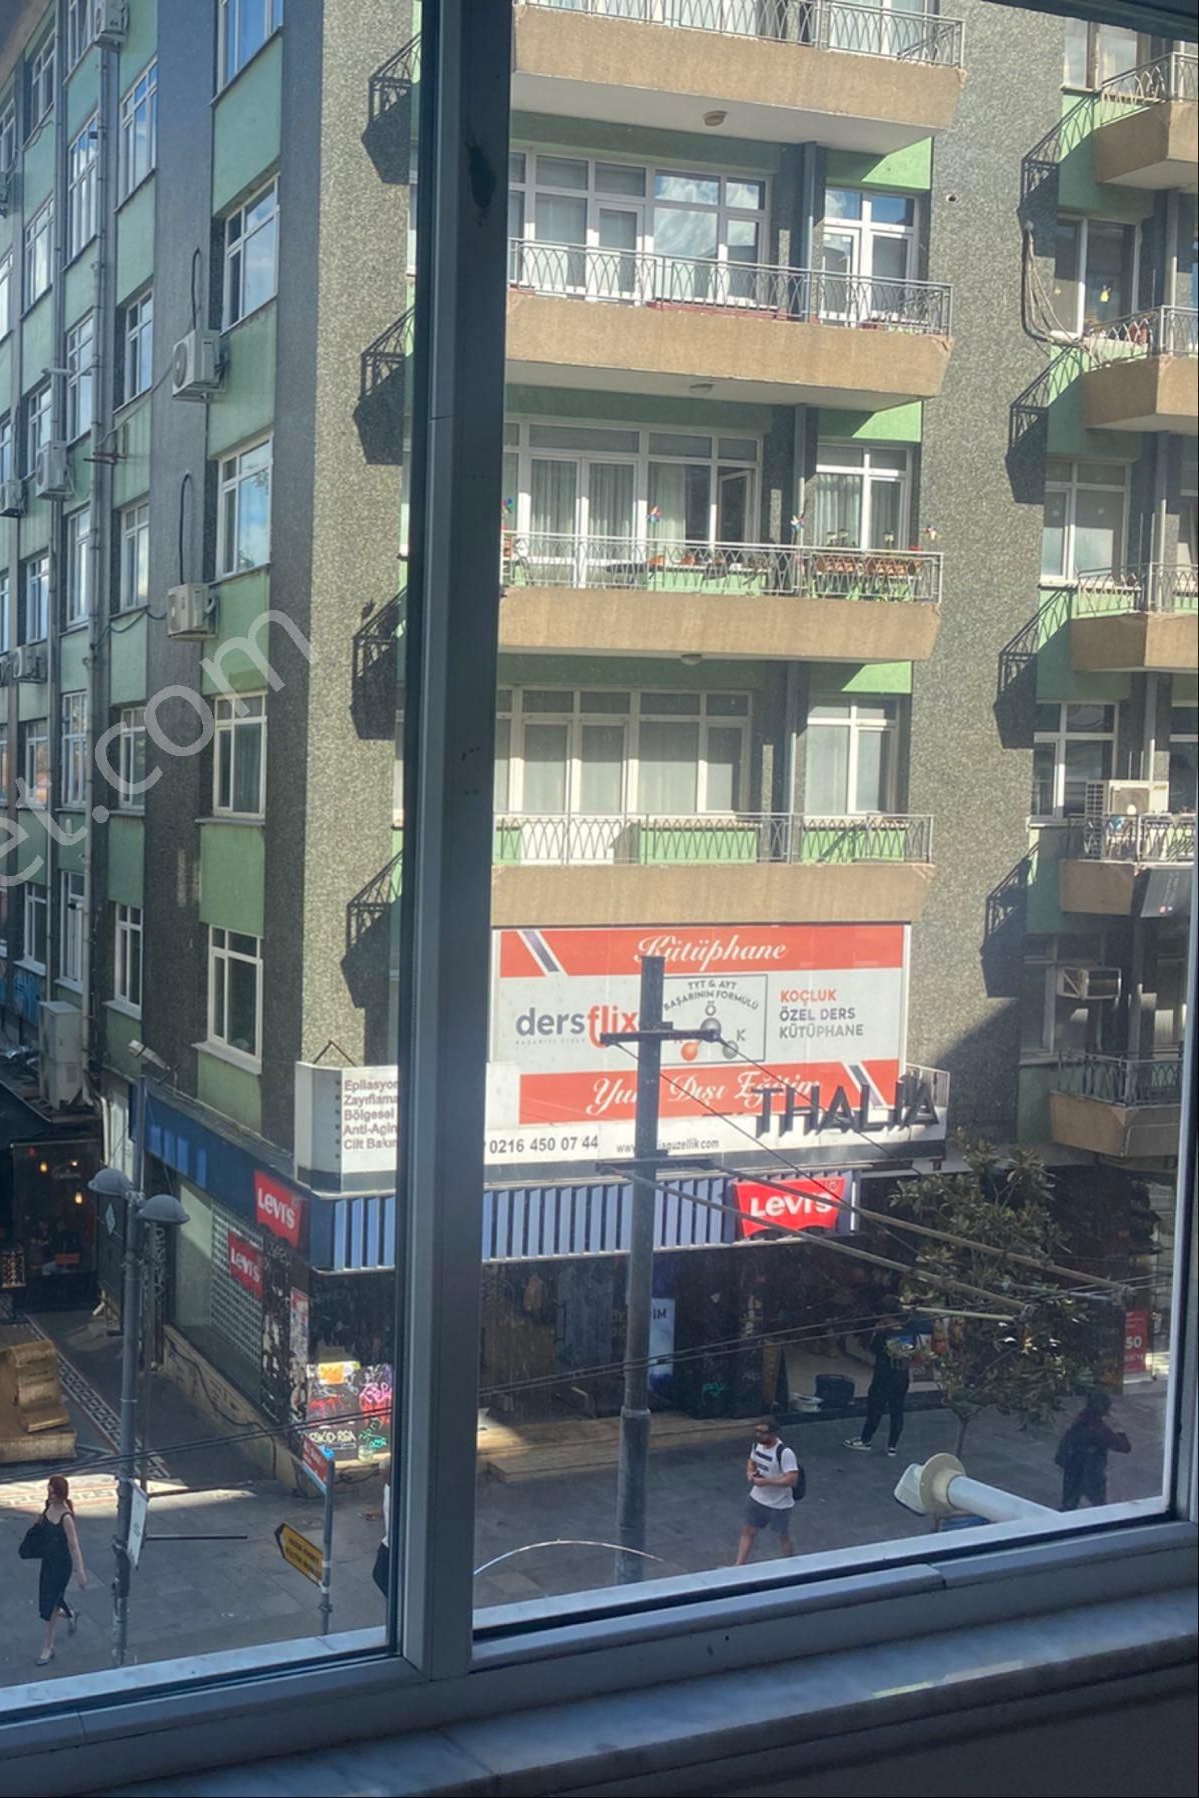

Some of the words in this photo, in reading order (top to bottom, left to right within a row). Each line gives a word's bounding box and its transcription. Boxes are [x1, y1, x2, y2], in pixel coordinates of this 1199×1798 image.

[688, 981, 707, 990] TYT
[719, 981, 738, 990] AYT
[780, 989, 836, 1006] KOÇLUK
[779, 1006, 815, 1021] ÖZEL
[820, 1007, 856, 1020] DERS
[516, 1004, 638, 1048] dersflix
[779, 1023, 864, 1039] KÜTÜPHANE
[344, 1107, 394, 1121] Bölgesel
[489, 1140, 524, 1154] 0216
[529, 1138, 556, 1152] 450
[561, 1137, 578, 1151] 07
[581, 1136, 598, 1149] 44
